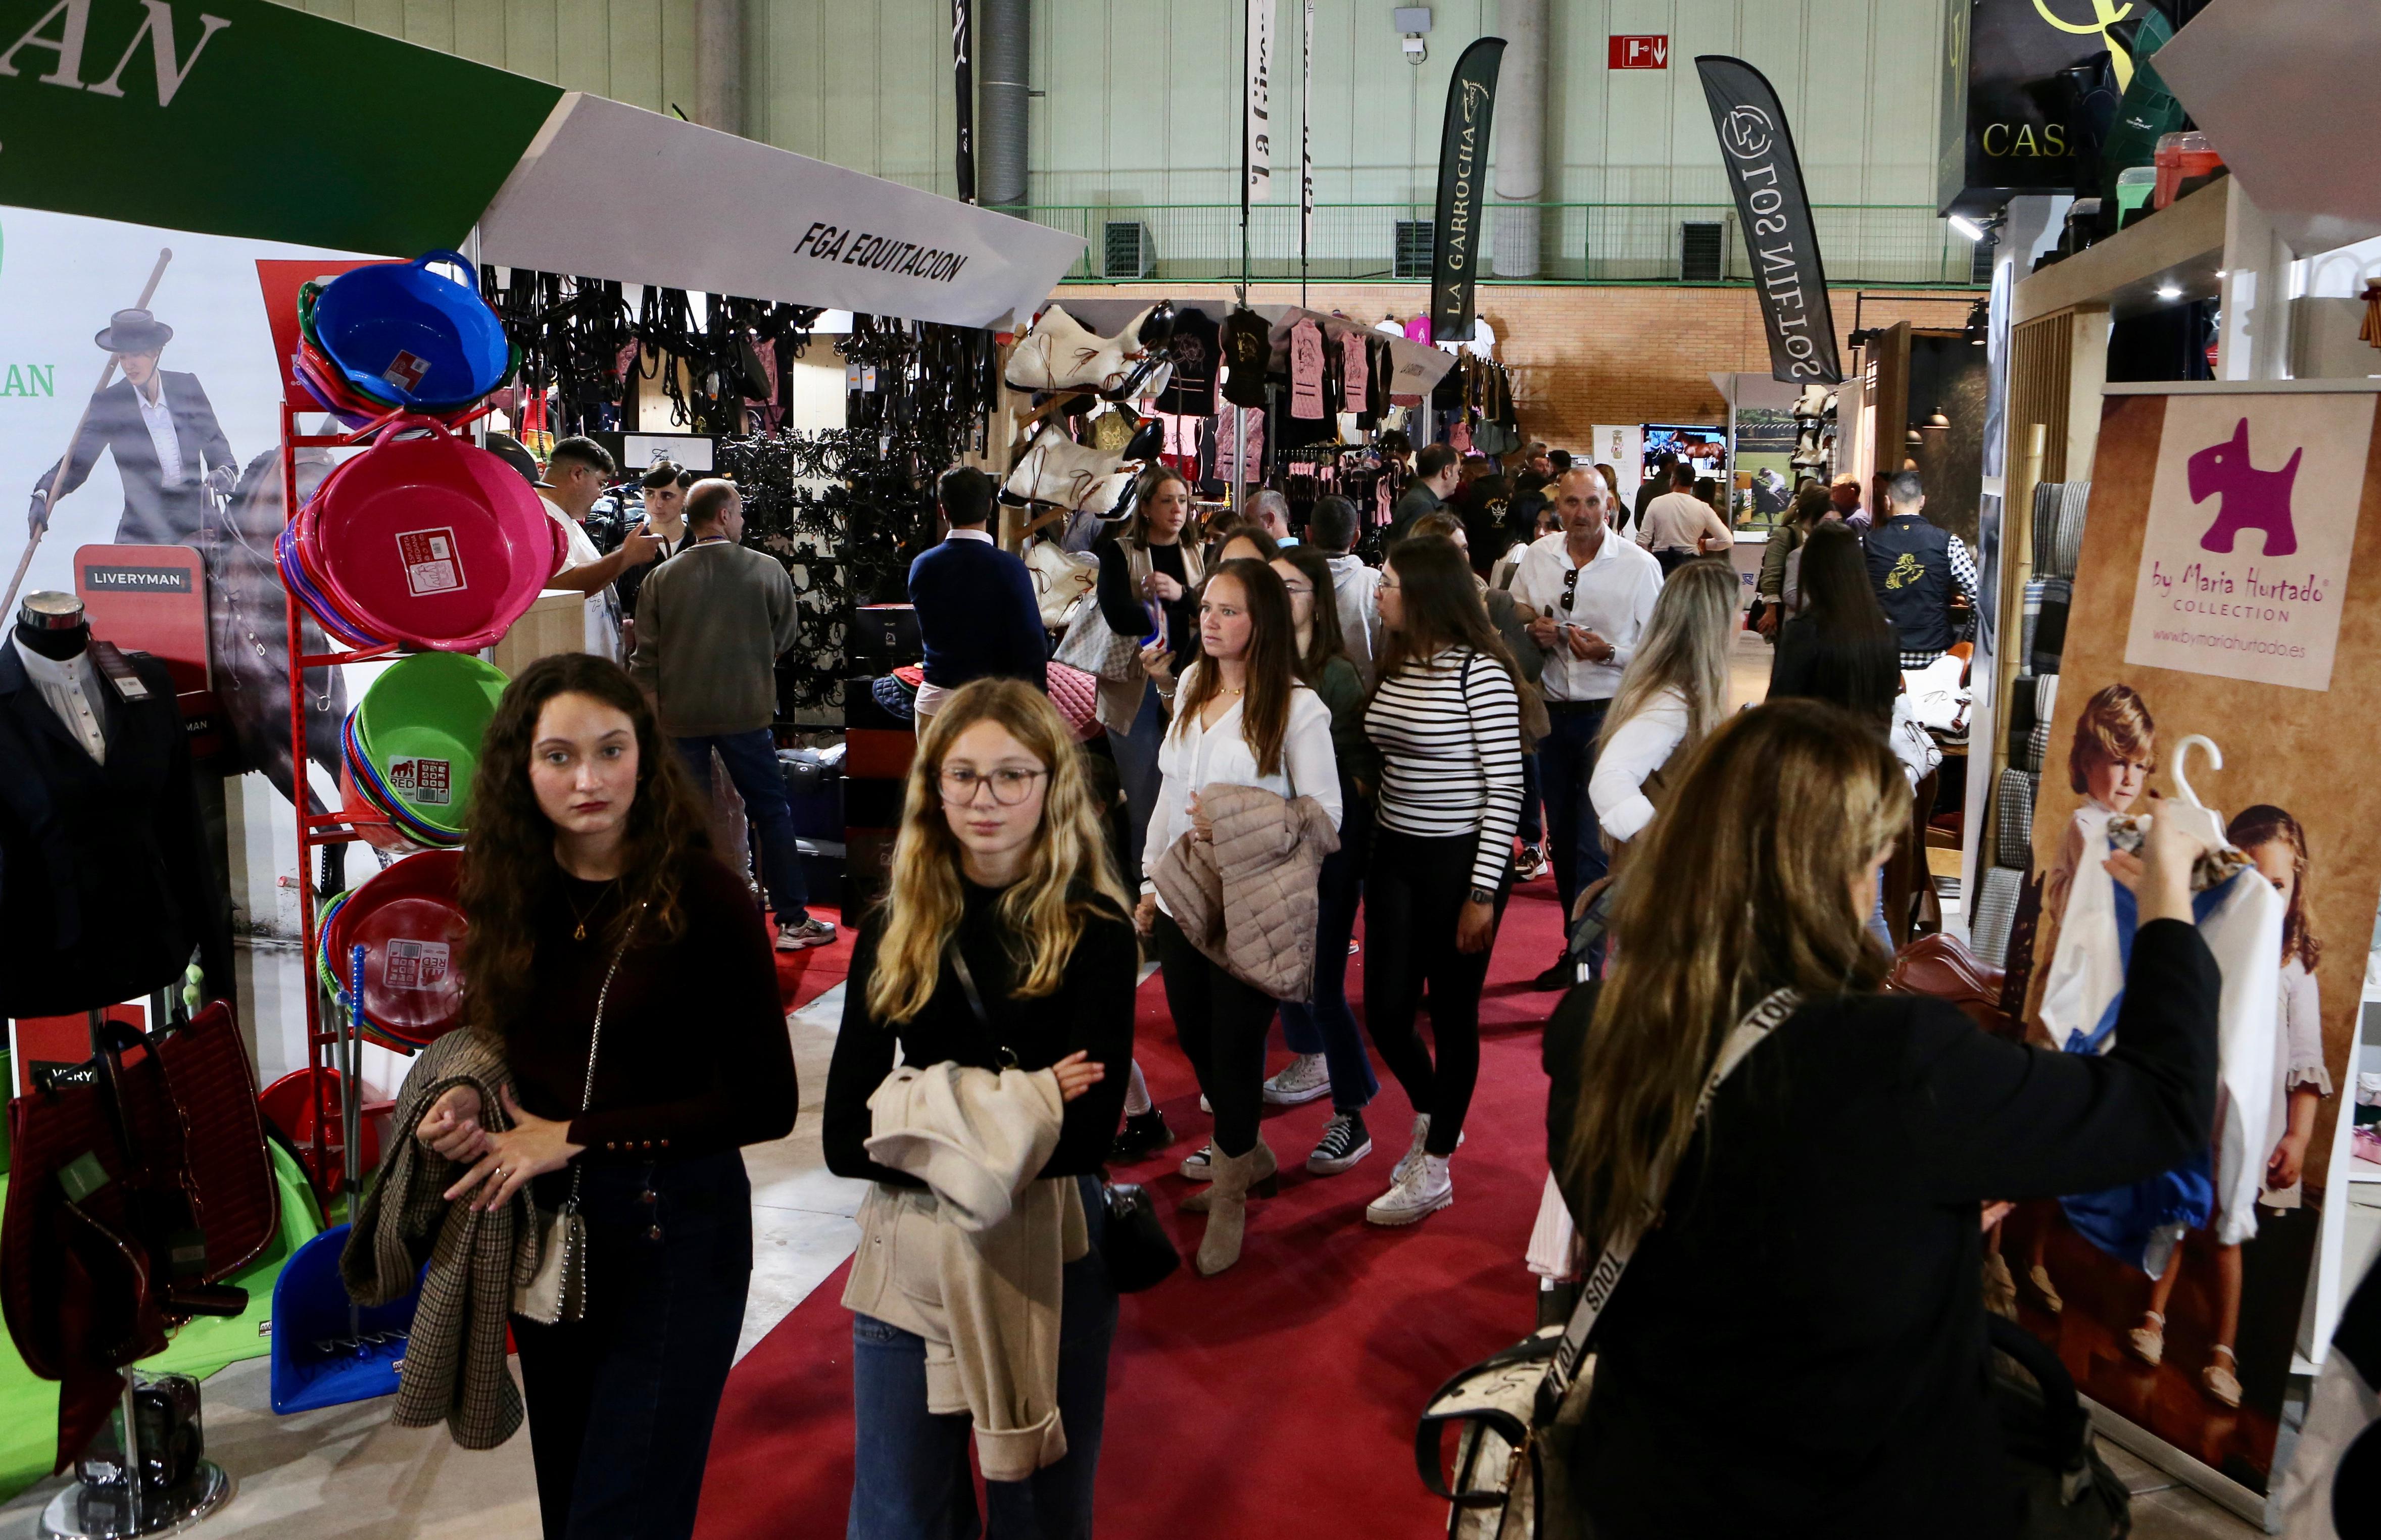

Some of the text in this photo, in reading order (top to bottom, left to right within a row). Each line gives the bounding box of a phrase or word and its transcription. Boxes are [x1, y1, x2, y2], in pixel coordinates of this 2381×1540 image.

[0, 0, 231, 107] AN
[1983, 124, 2076, 157] CAS
[1447, 126, 1475, 315] LA GARROCHA
[793, 222, 968, 282] FGA EQUITACION
[0, 365, 54, 396] AN
[404, 535, 415, 563] ESPUERTA
[411, 535, 422, 562] MEDIANA
[94, 573, 180, 585] LIVERYMAN
[2153, 561, 2322, 602] by Maria Hurtado
[2174, 600, 2289, 622] COLLECTION
[2153, 629, 2305, 658] www.bymariahurtado.es
[390, 778, 414, 788] RED
[422, 957, 446, 967] RED
[1586, 1252, 1625, 1312] TOUS
